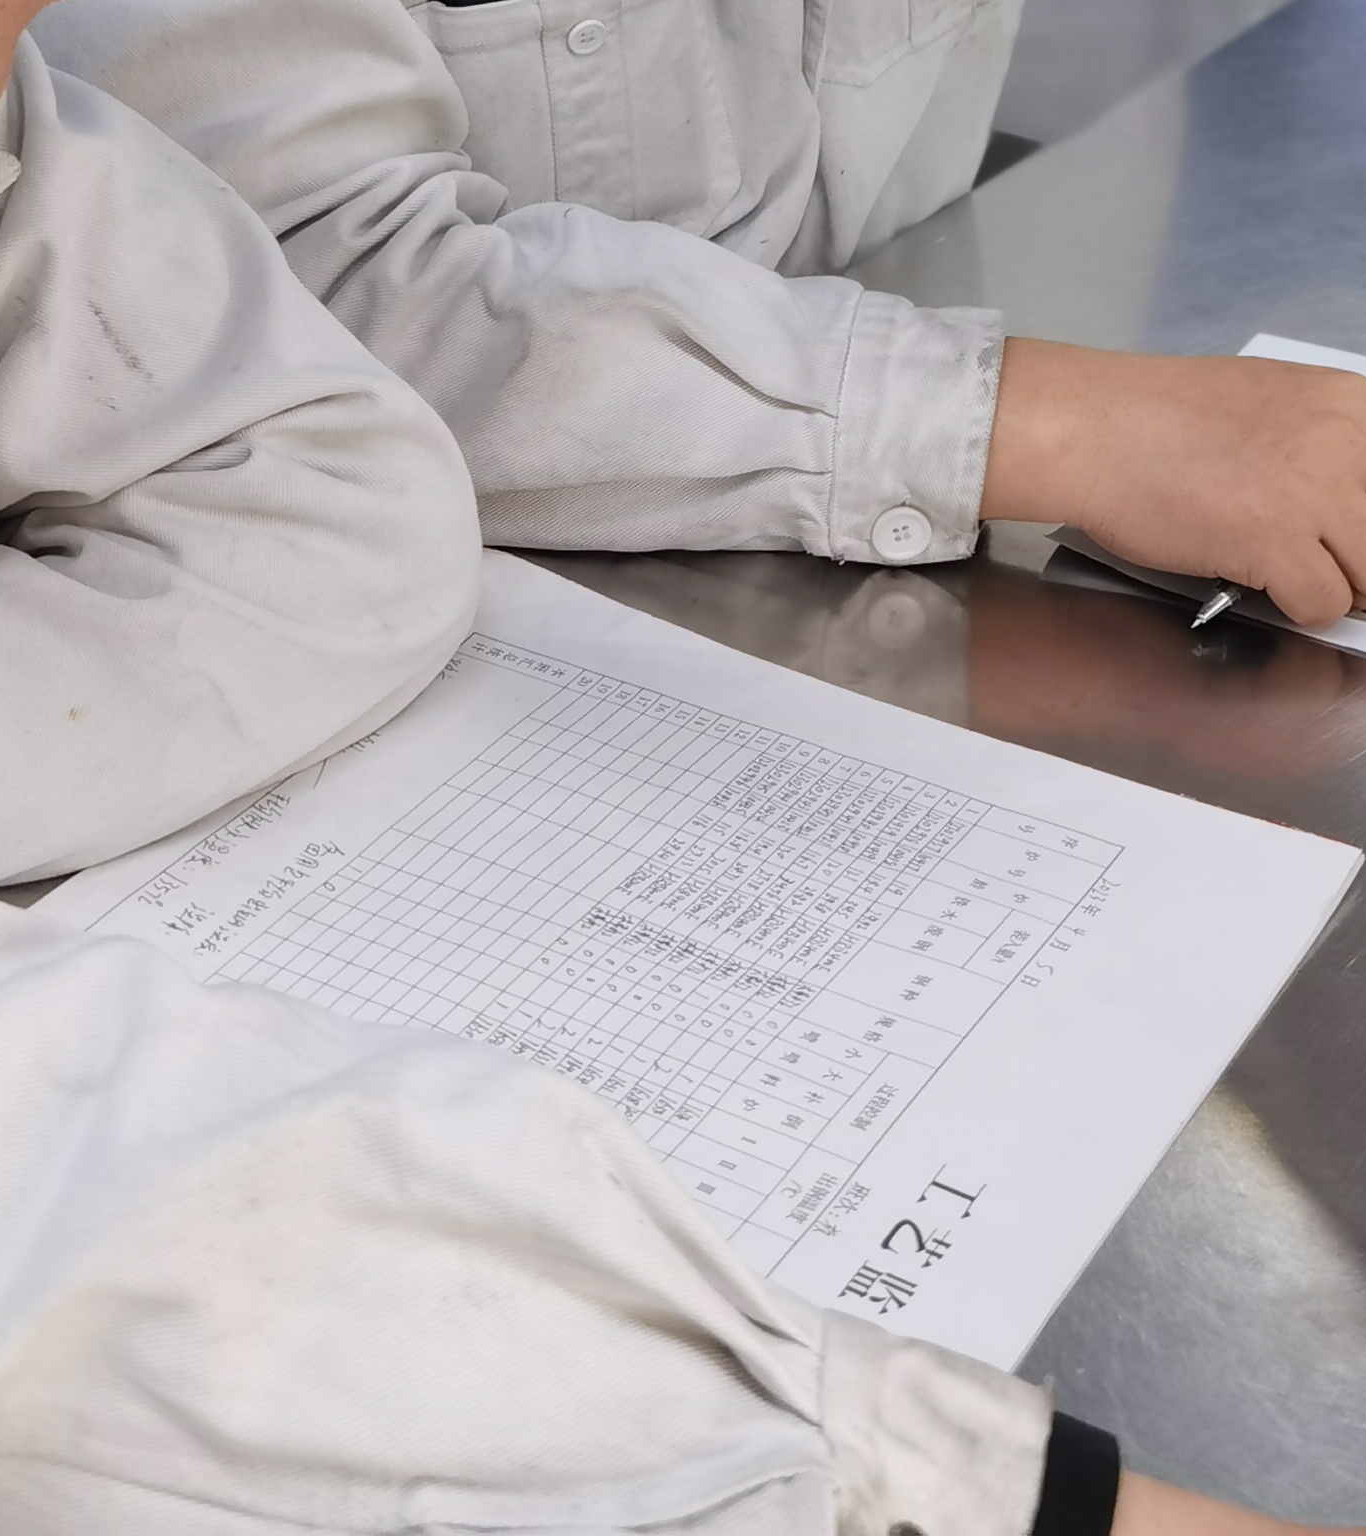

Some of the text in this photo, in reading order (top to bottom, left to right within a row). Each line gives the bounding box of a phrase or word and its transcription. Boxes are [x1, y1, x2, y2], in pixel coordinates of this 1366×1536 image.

[1016, 822, 1079, 849] 序号
[1005, 849, 1041, 878] 炉号
[938, 895, 971, 921] 铁水
[898, 973, 933, 1002] 钢种
[861, 1014, 897, 1043] 规格
[849, 1082, 899, 1131] 过程控制
[785, 1172, 839, 1224] 出钢温度
[837, 1165, 994, 1316] 工艺监
